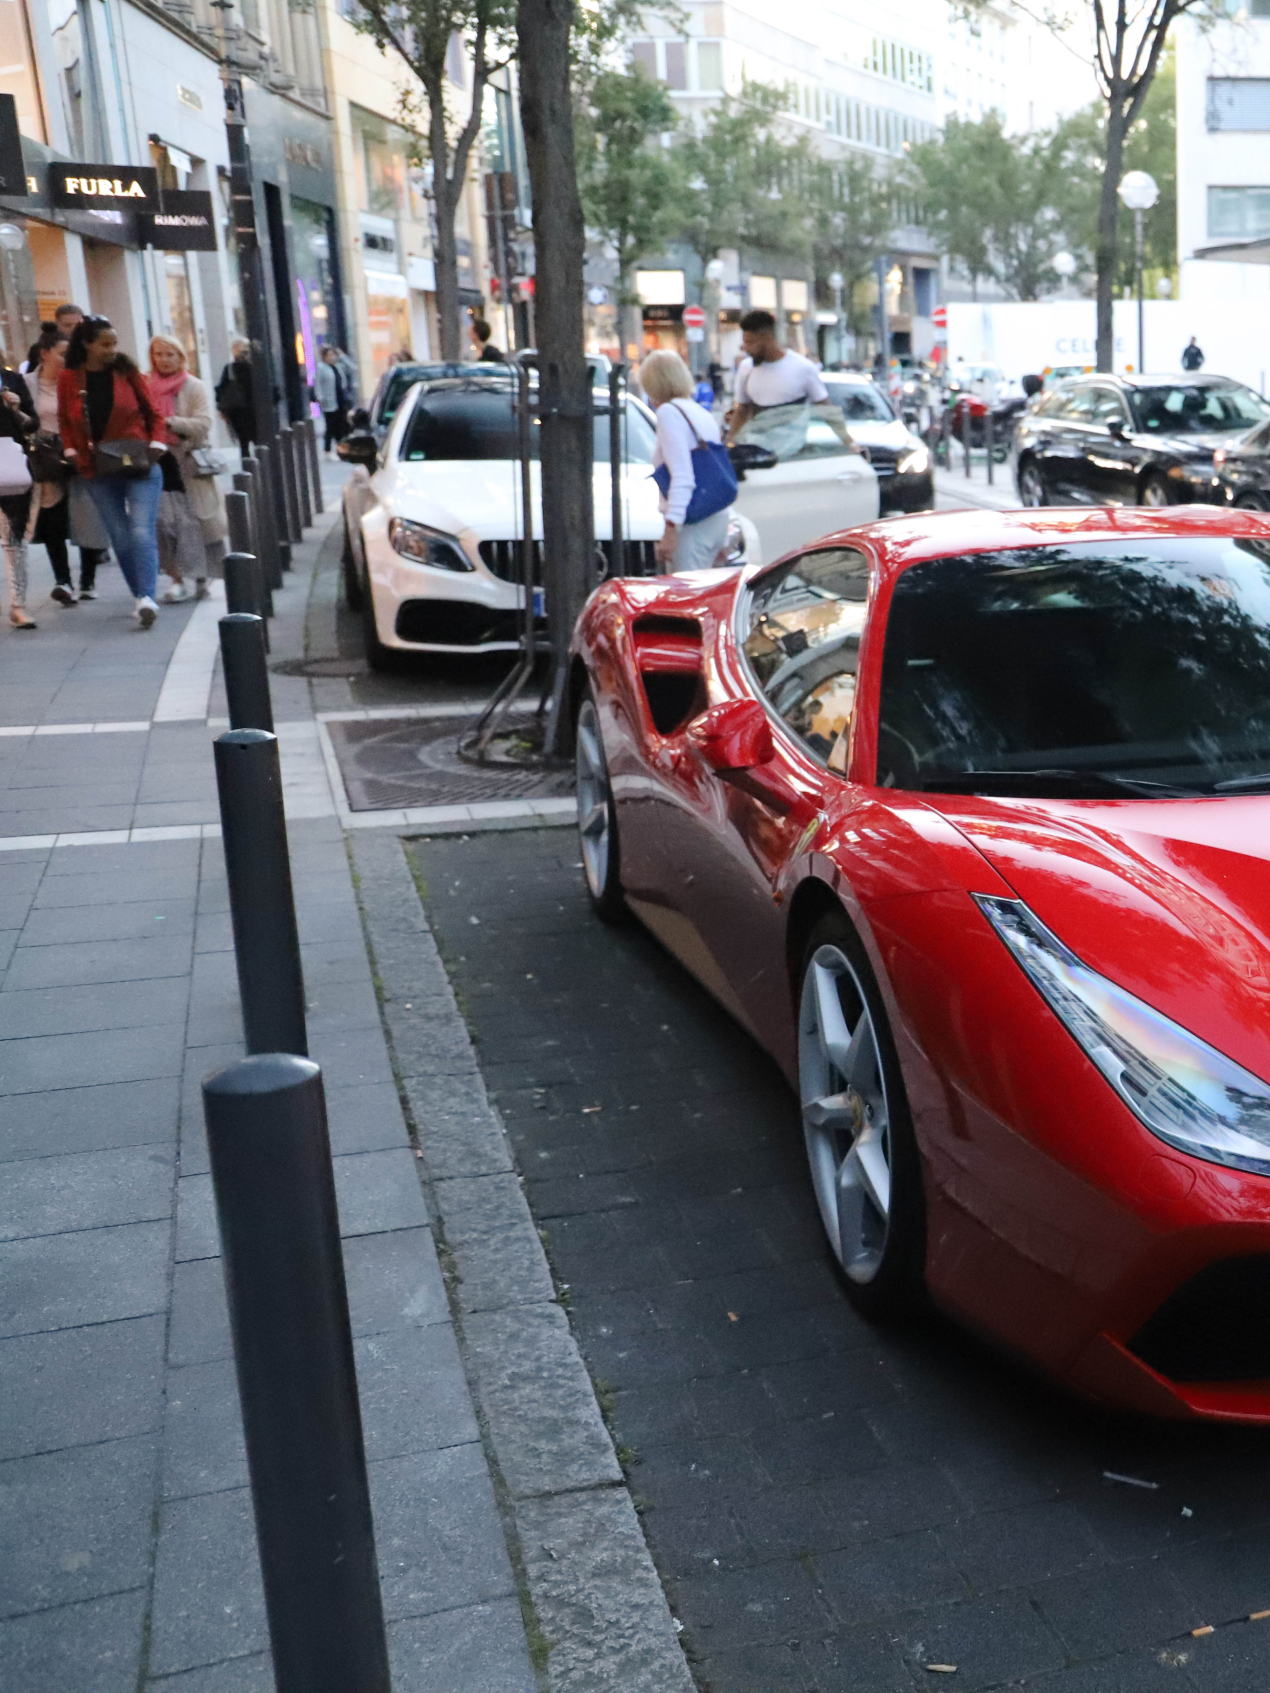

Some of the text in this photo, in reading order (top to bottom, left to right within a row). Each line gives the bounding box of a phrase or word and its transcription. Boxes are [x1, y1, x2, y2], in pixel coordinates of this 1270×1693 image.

[64, 177, 147, 198] FURLA
[154, 214, 210, 227] RIMOWA
[1055, 336, 1126, 354] CELE
